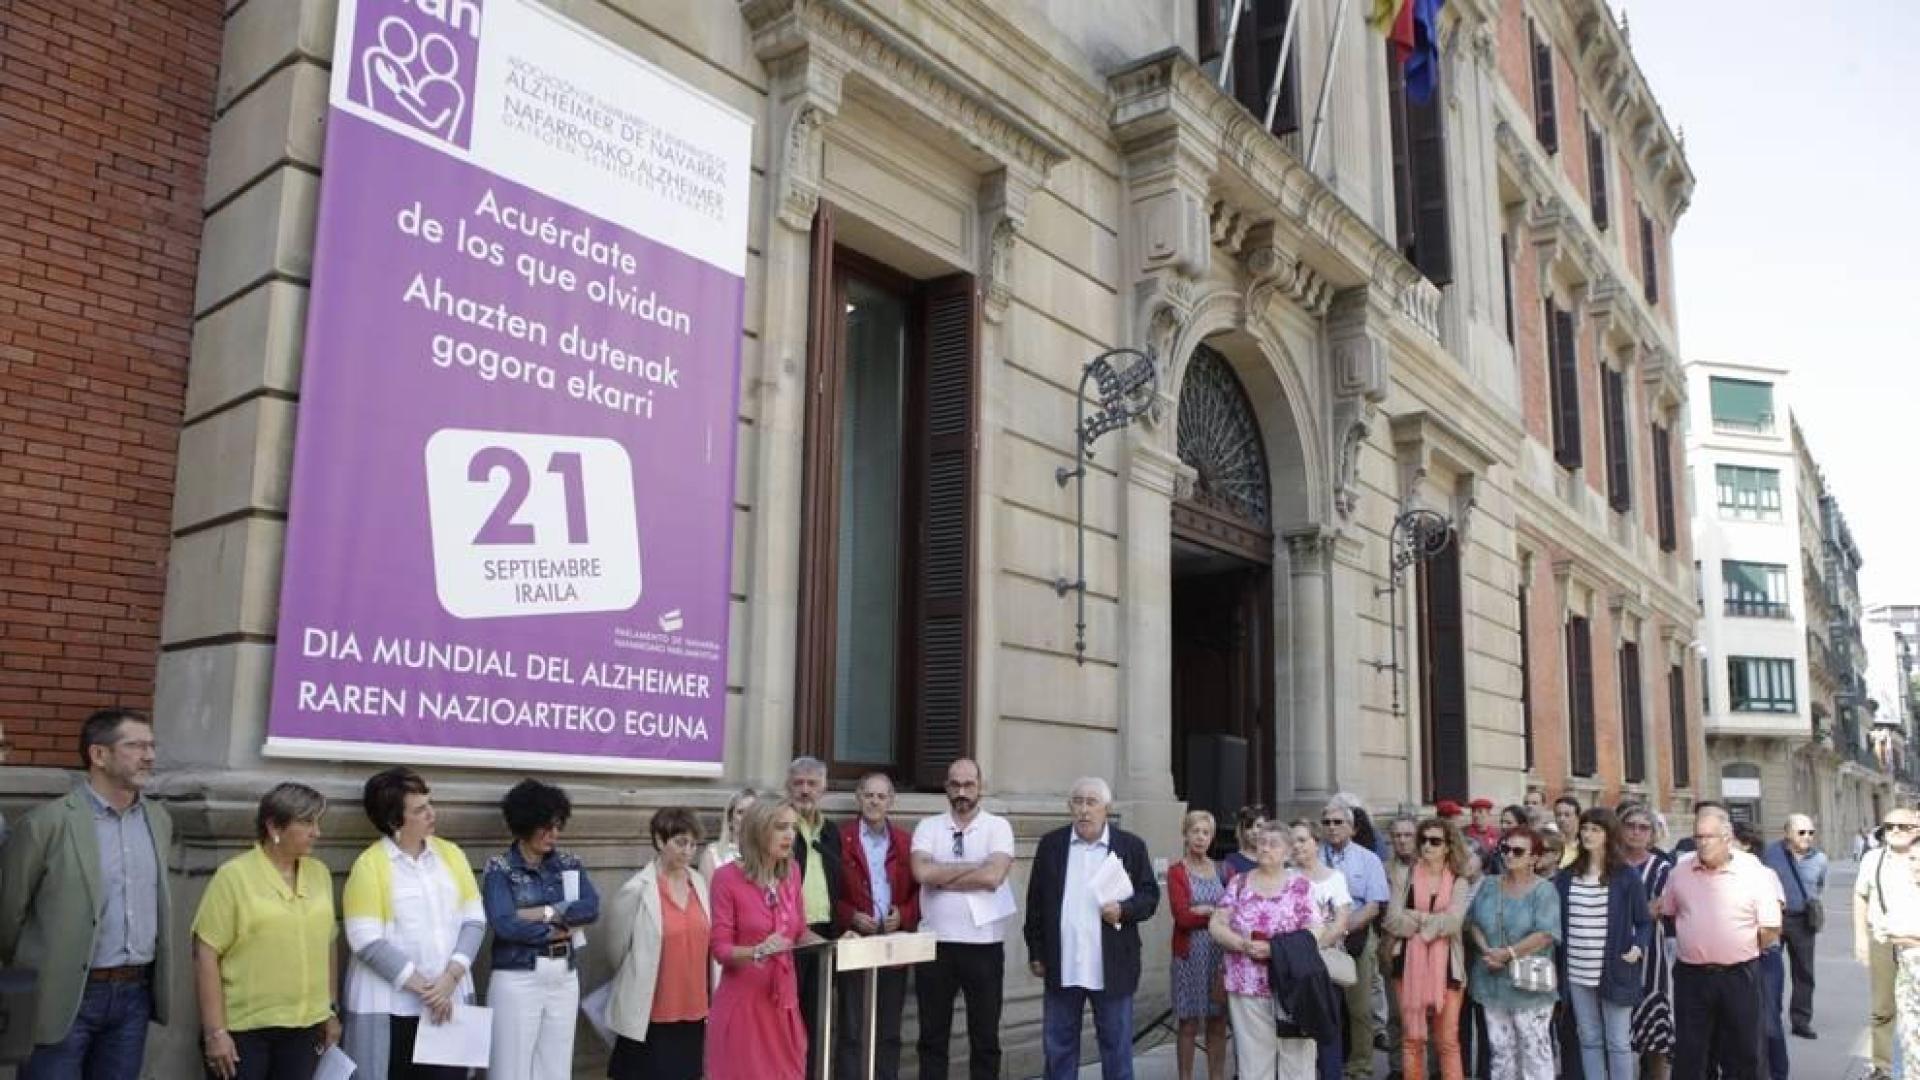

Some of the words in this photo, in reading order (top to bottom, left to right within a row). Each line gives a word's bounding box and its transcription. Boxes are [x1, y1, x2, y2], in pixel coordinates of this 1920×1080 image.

[504, 94, 632, 166] NAFARROAKO
[637, 158, 724, 206] ALZHEIMER
[505, 70, 614, 130] ALZHEIMER
[620, 123, 647, 148] DE
[650, 139, 726, 188] NAVARRA
[397, 201, 444, 243] de
[458, 219, 504, 266] los
[516, 252, 576, 291] que
[587, 275, 690, 334] olvidan
[475, 187, 637, 274] Acuérdate
[403, 272, 547, 345] Ahazten
[560, 325, 679, 388] dutenak
[432, 334, 555, 390] gogora
[567, 369, 653, 419] ekarri
[466, 445, 589, 546] 21
[484, 558, 601, 581] SEPTIEMBRE
[515, 583, 577, 604] IRAILA
[303, 628, 362, 661] DIA
[372, 636, 517, 679] MUNDIAL
[527, 655, 574, 685] DEL
[582, 662, 709, 699] ALZHEIMER
[298, 682, 406, 716] RAREN
[418, 692, 615, 734] NAZIOARTEKO
[625, 713, 708, 741] EGUNA
